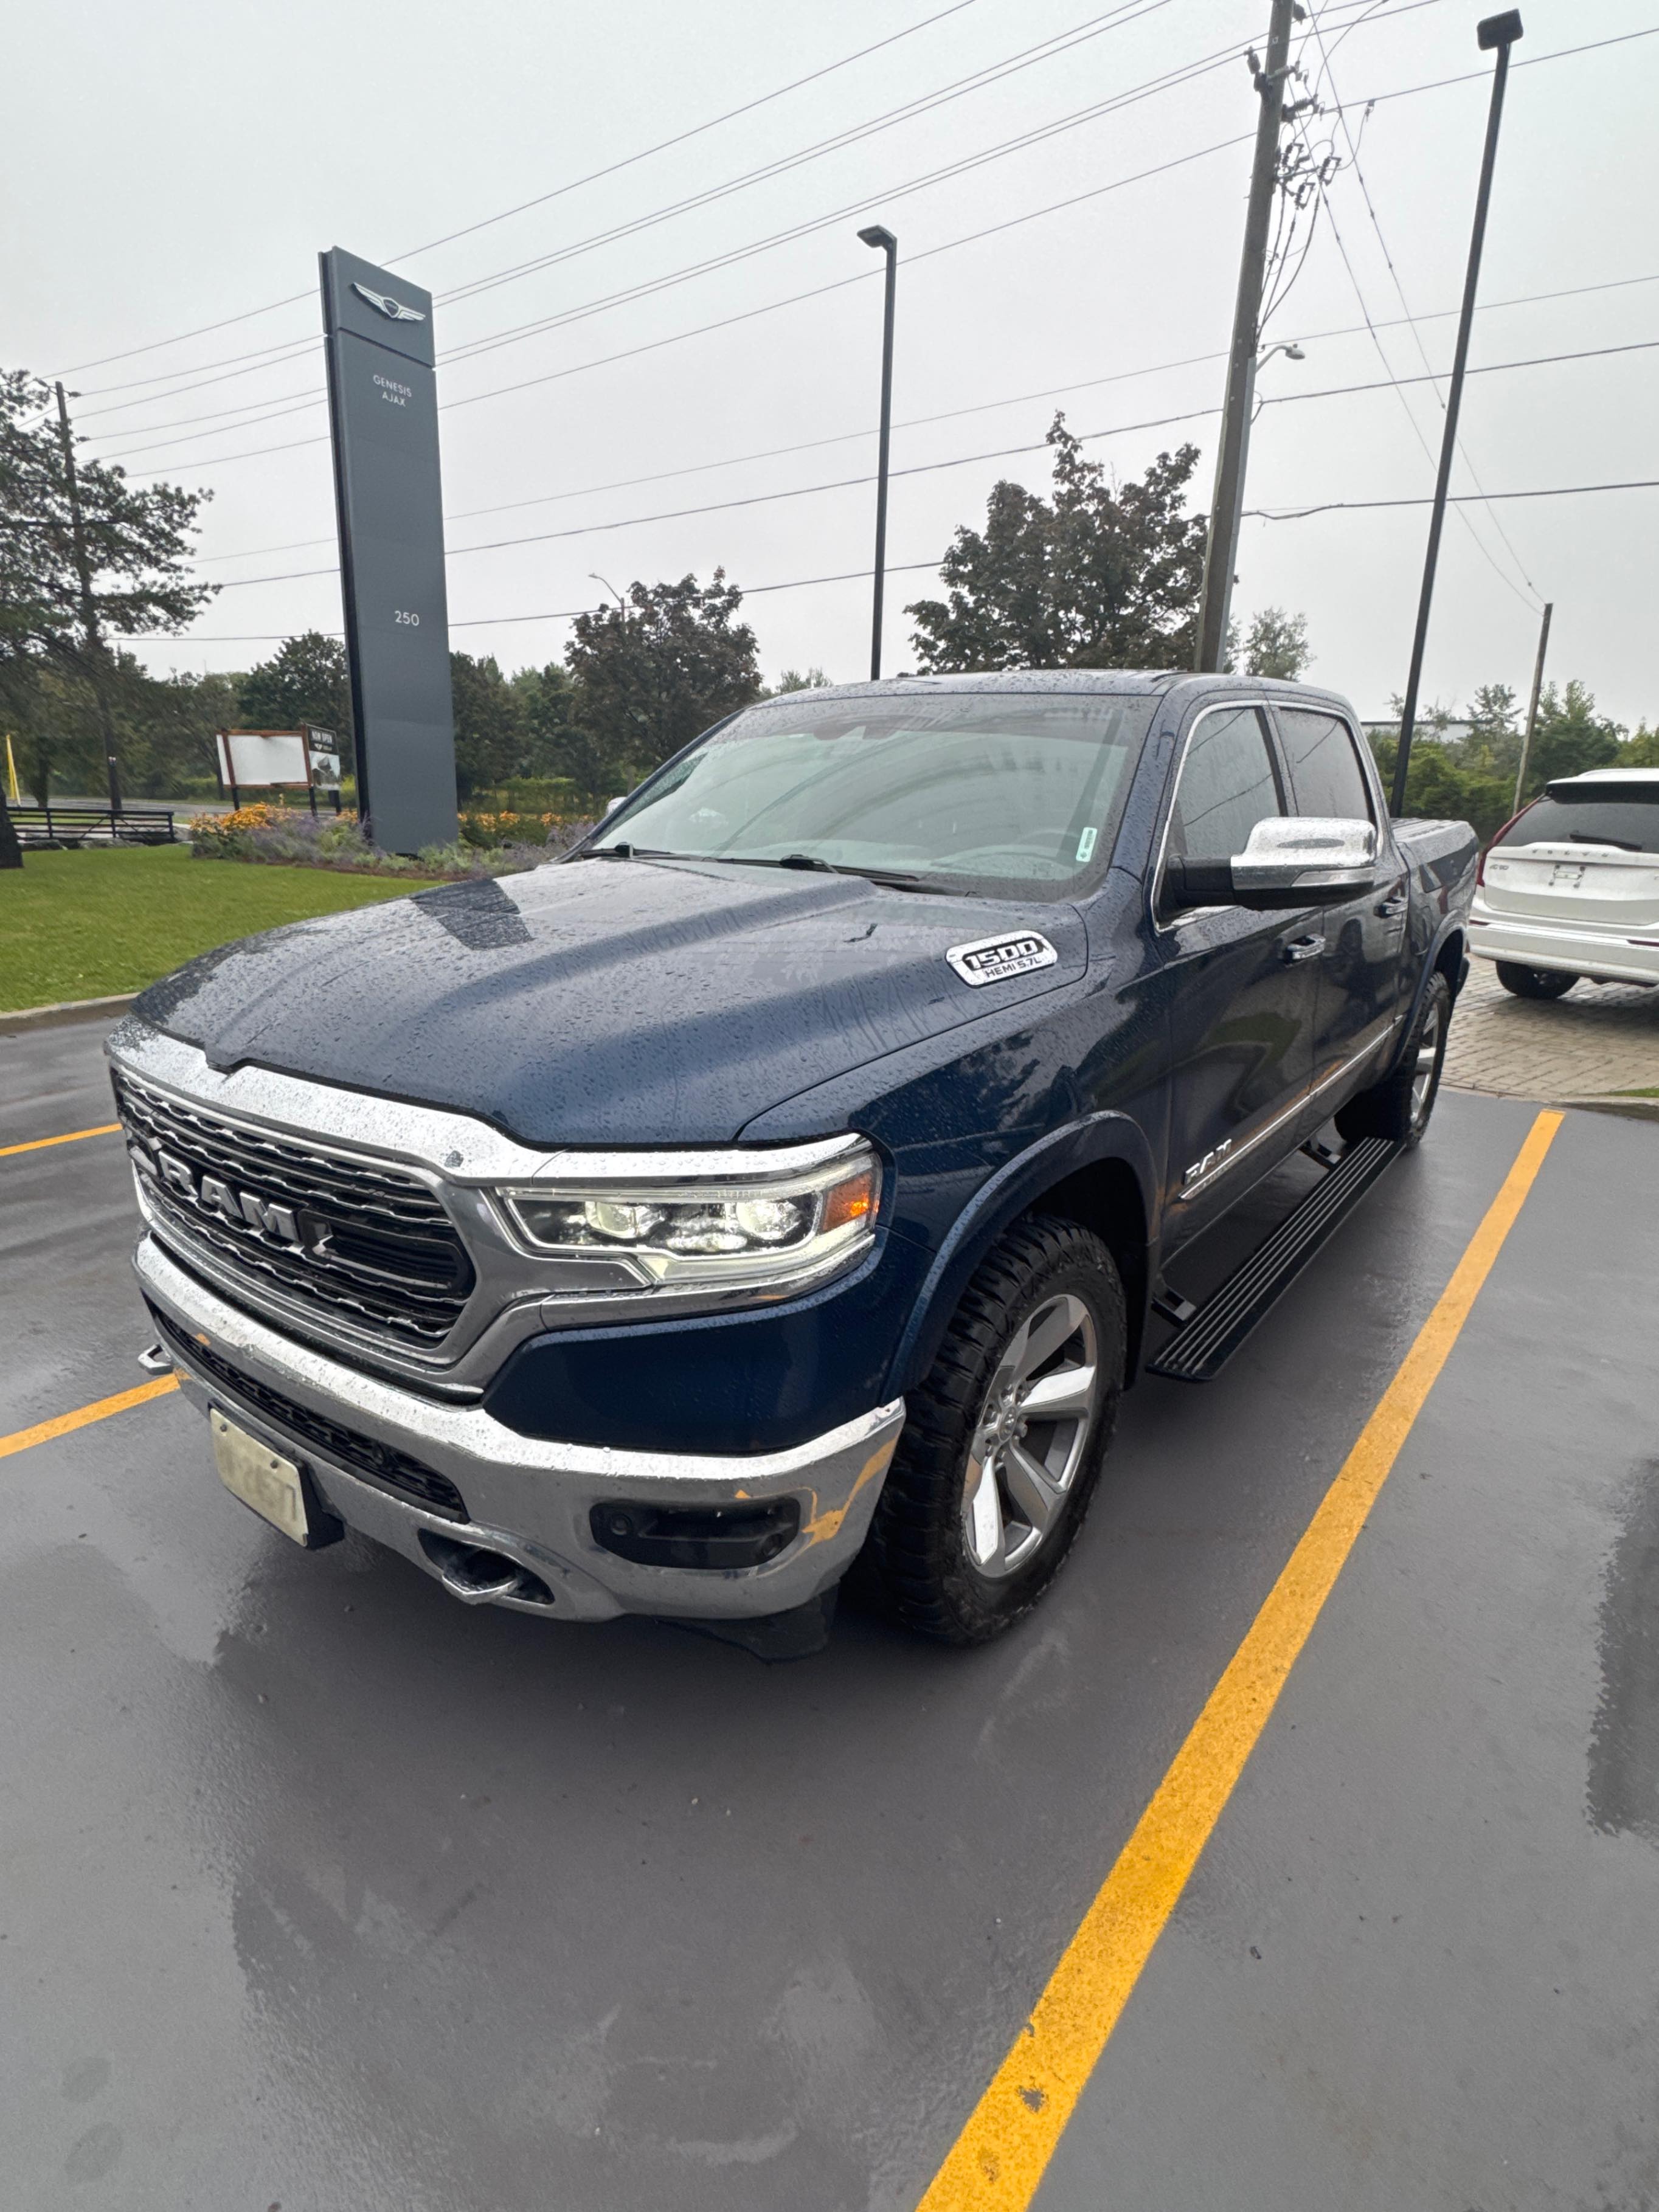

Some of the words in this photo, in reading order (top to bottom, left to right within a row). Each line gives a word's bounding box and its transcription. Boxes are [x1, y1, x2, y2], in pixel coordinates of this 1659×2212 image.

[373, 375, 412, 398] GENESIS
[382, 392, 406, 407] AJAX
[394, 610, 420, 626] 250
[965, 940, 1038, 970] 1500
[985, 964, 1016, 978] HEMI
[1016, 956, 1043, 969] 5.7L
[158, 1150, 300, 1243] RAM
